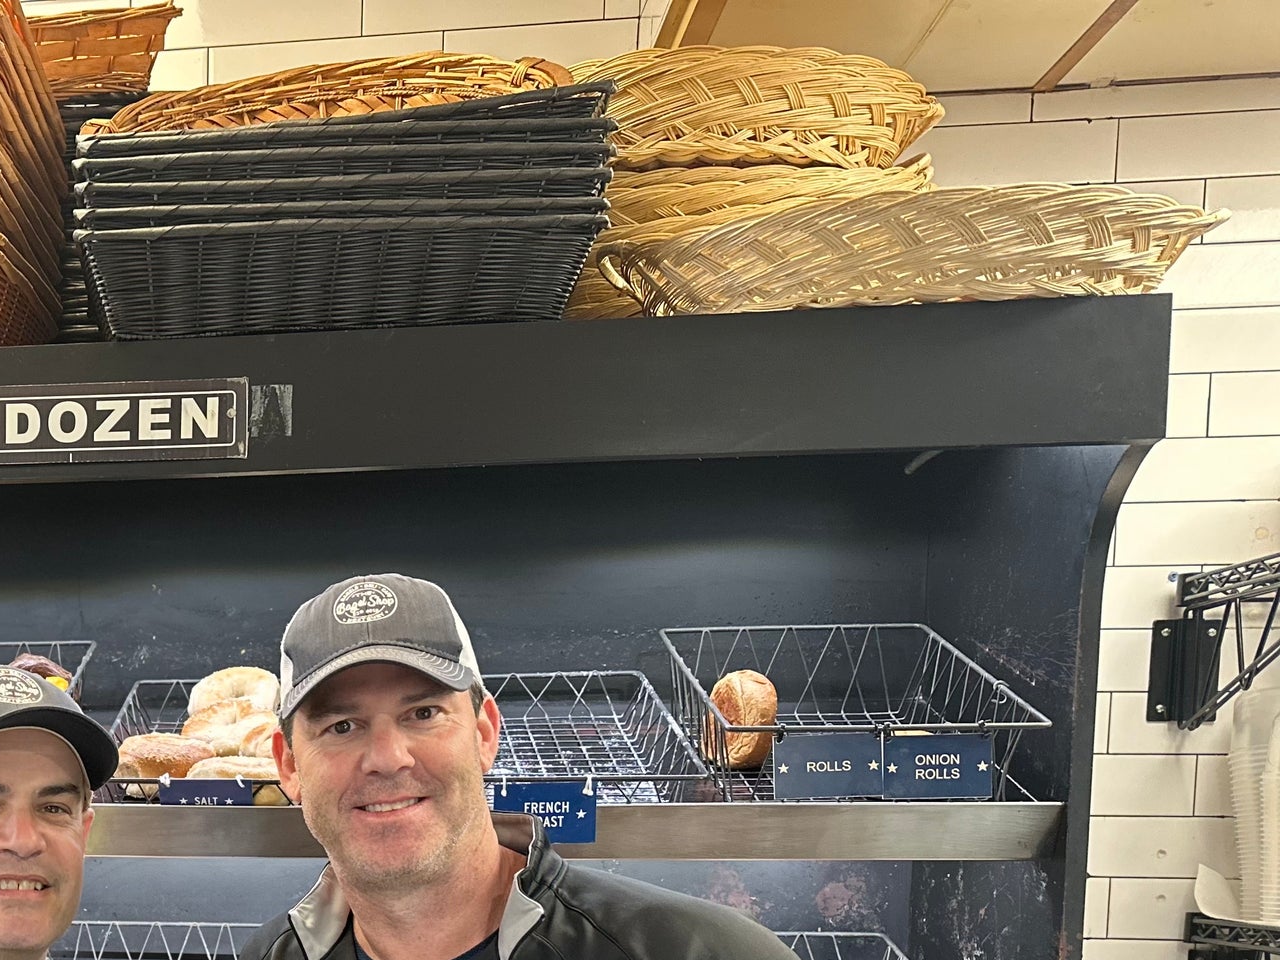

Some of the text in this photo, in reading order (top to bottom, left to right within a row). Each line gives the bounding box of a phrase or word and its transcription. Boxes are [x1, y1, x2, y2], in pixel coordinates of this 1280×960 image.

[4, 396, 220, 445] DOZEN
[915, 754, 960, 766] ONION
[806, 760, 852, 773] ROLLS
[915, 768, 960, 780] ROLLS
[194, 797, 218, 805] SALT
[524, 801, 569, 813] FRENCH
[538, 816, 564, 827] AST
